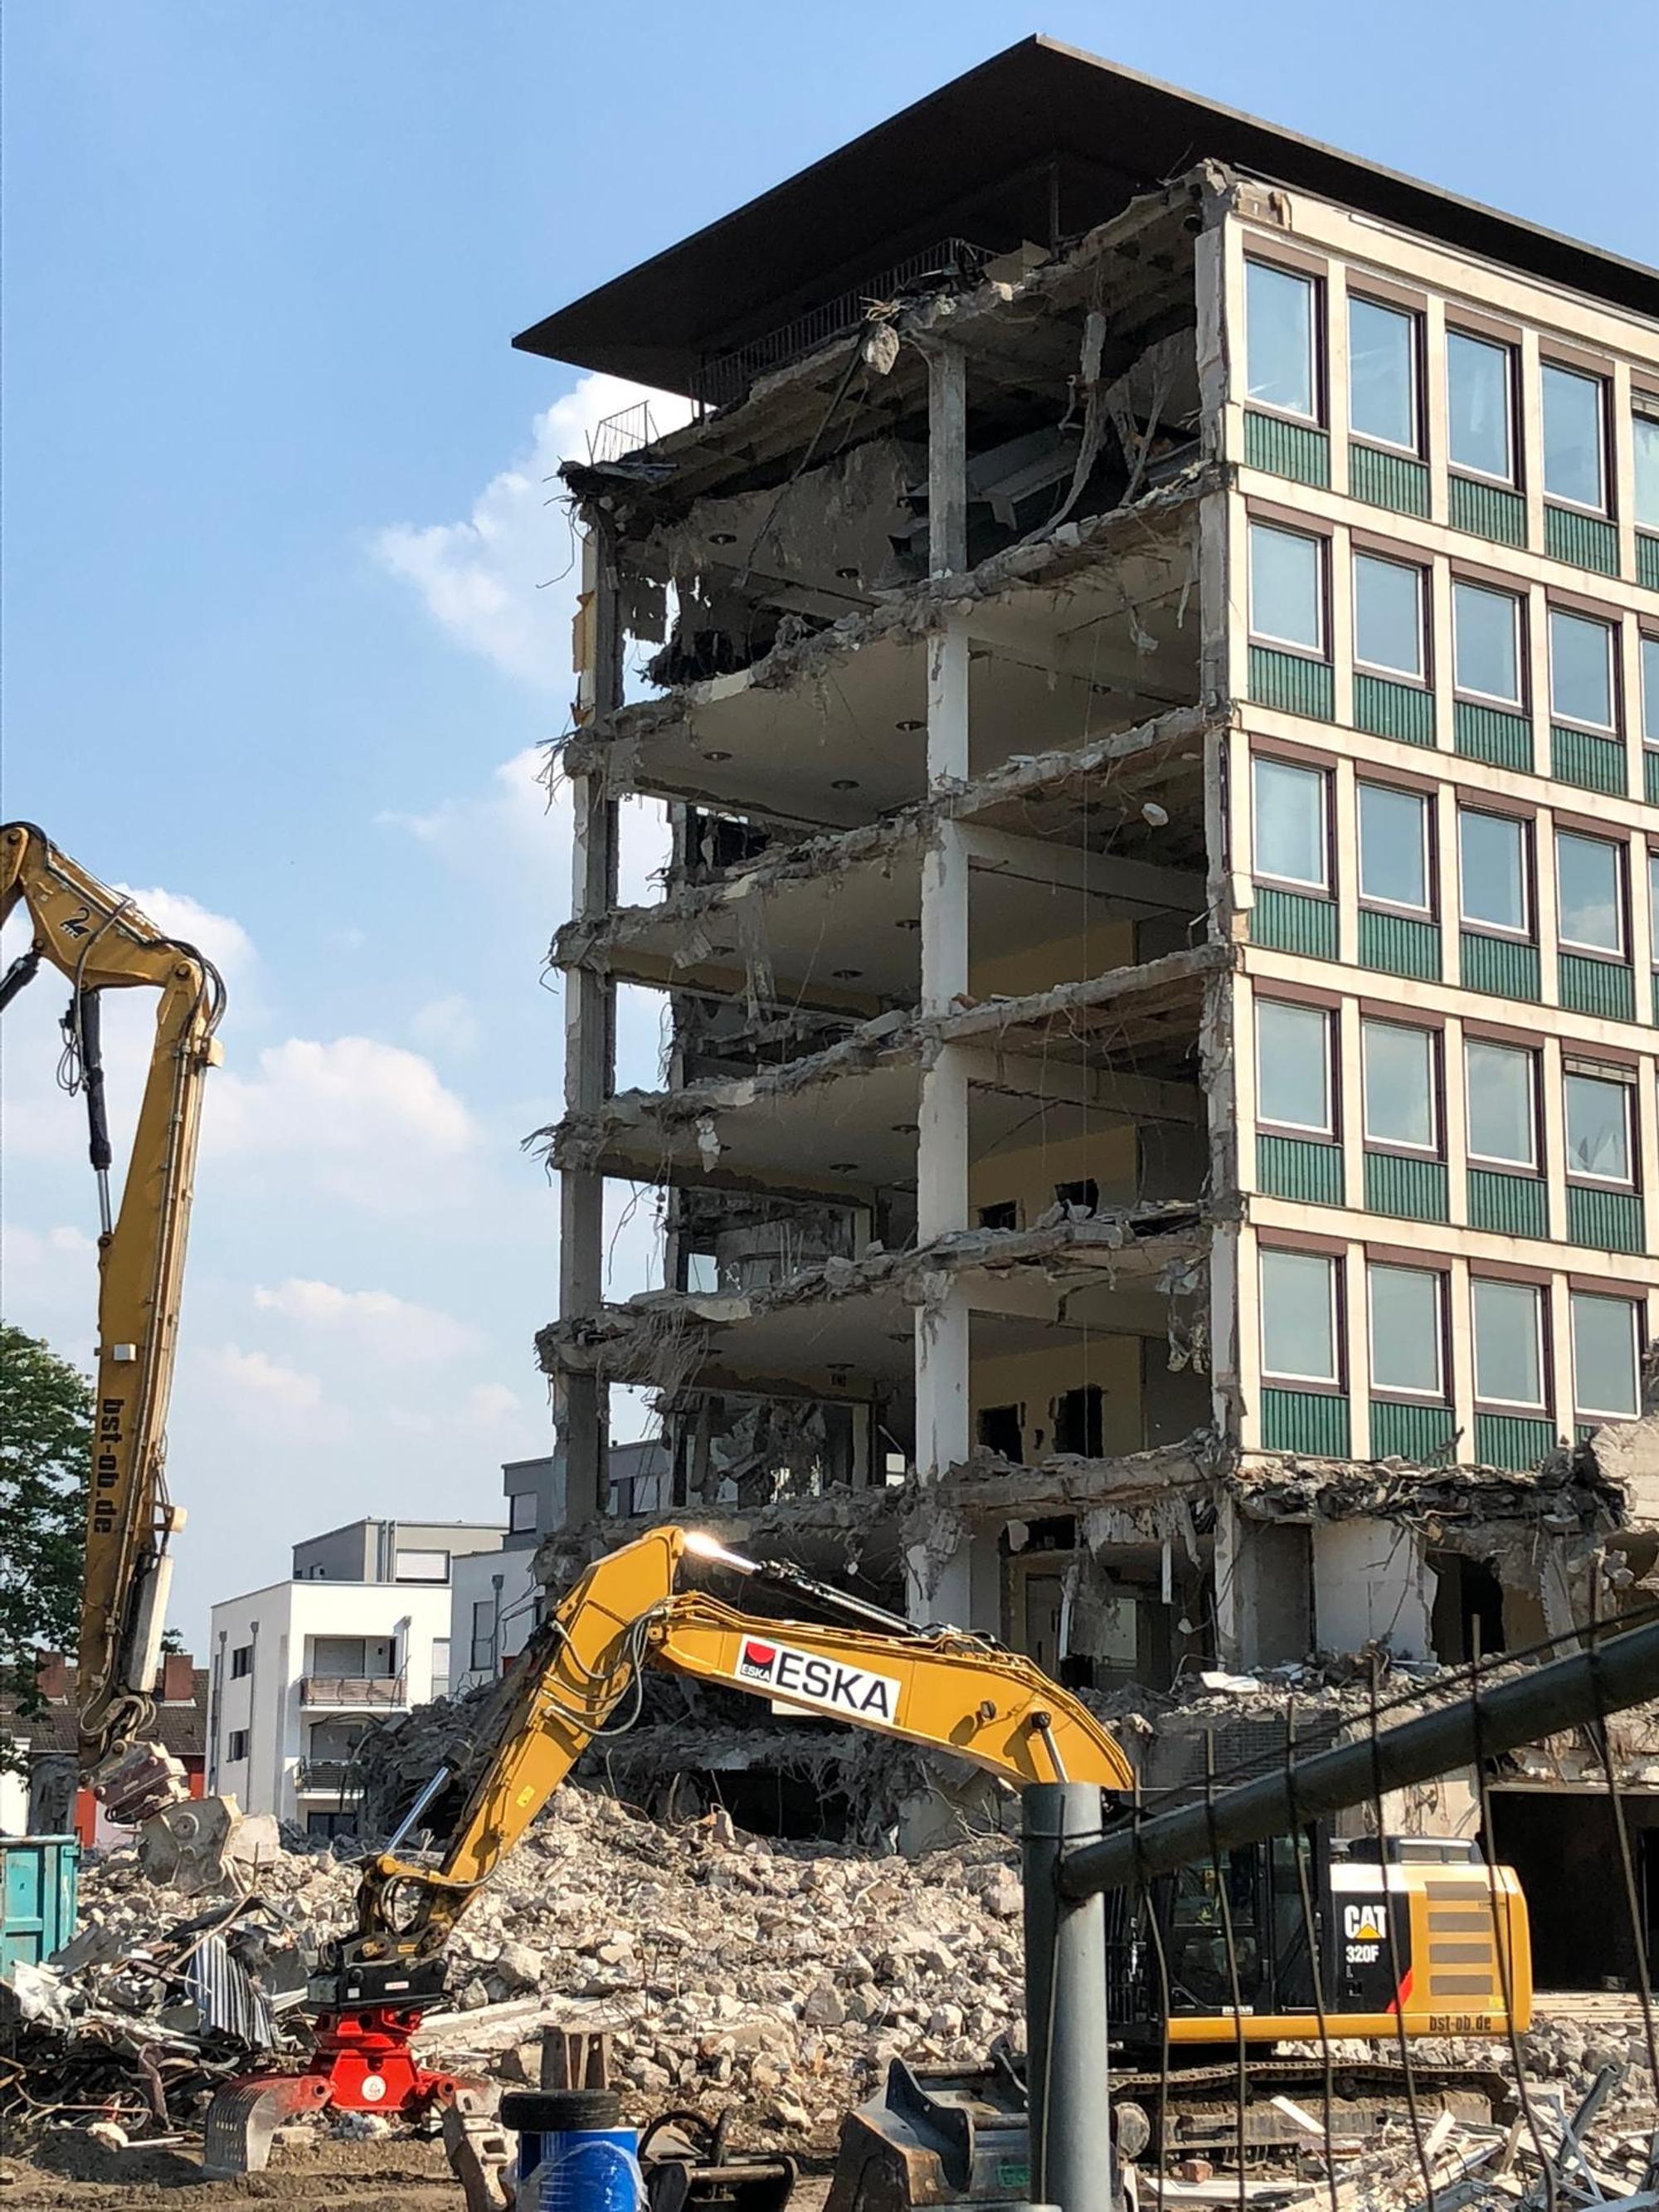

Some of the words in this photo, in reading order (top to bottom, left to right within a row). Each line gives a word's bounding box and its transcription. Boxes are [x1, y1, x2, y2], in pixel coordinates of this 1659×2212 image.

[94, 1399, 124, 1533] bst-ob.de
[741, 1664, 771, 1682] ESKA
[776, 1651, 889, 1718] ESKA
[1345, 1905, 1386, 1939] CAT
[1345, 1945, 1379, 1963] 320F
[1429, 2015, 1491, 2032] bst-ob.de
